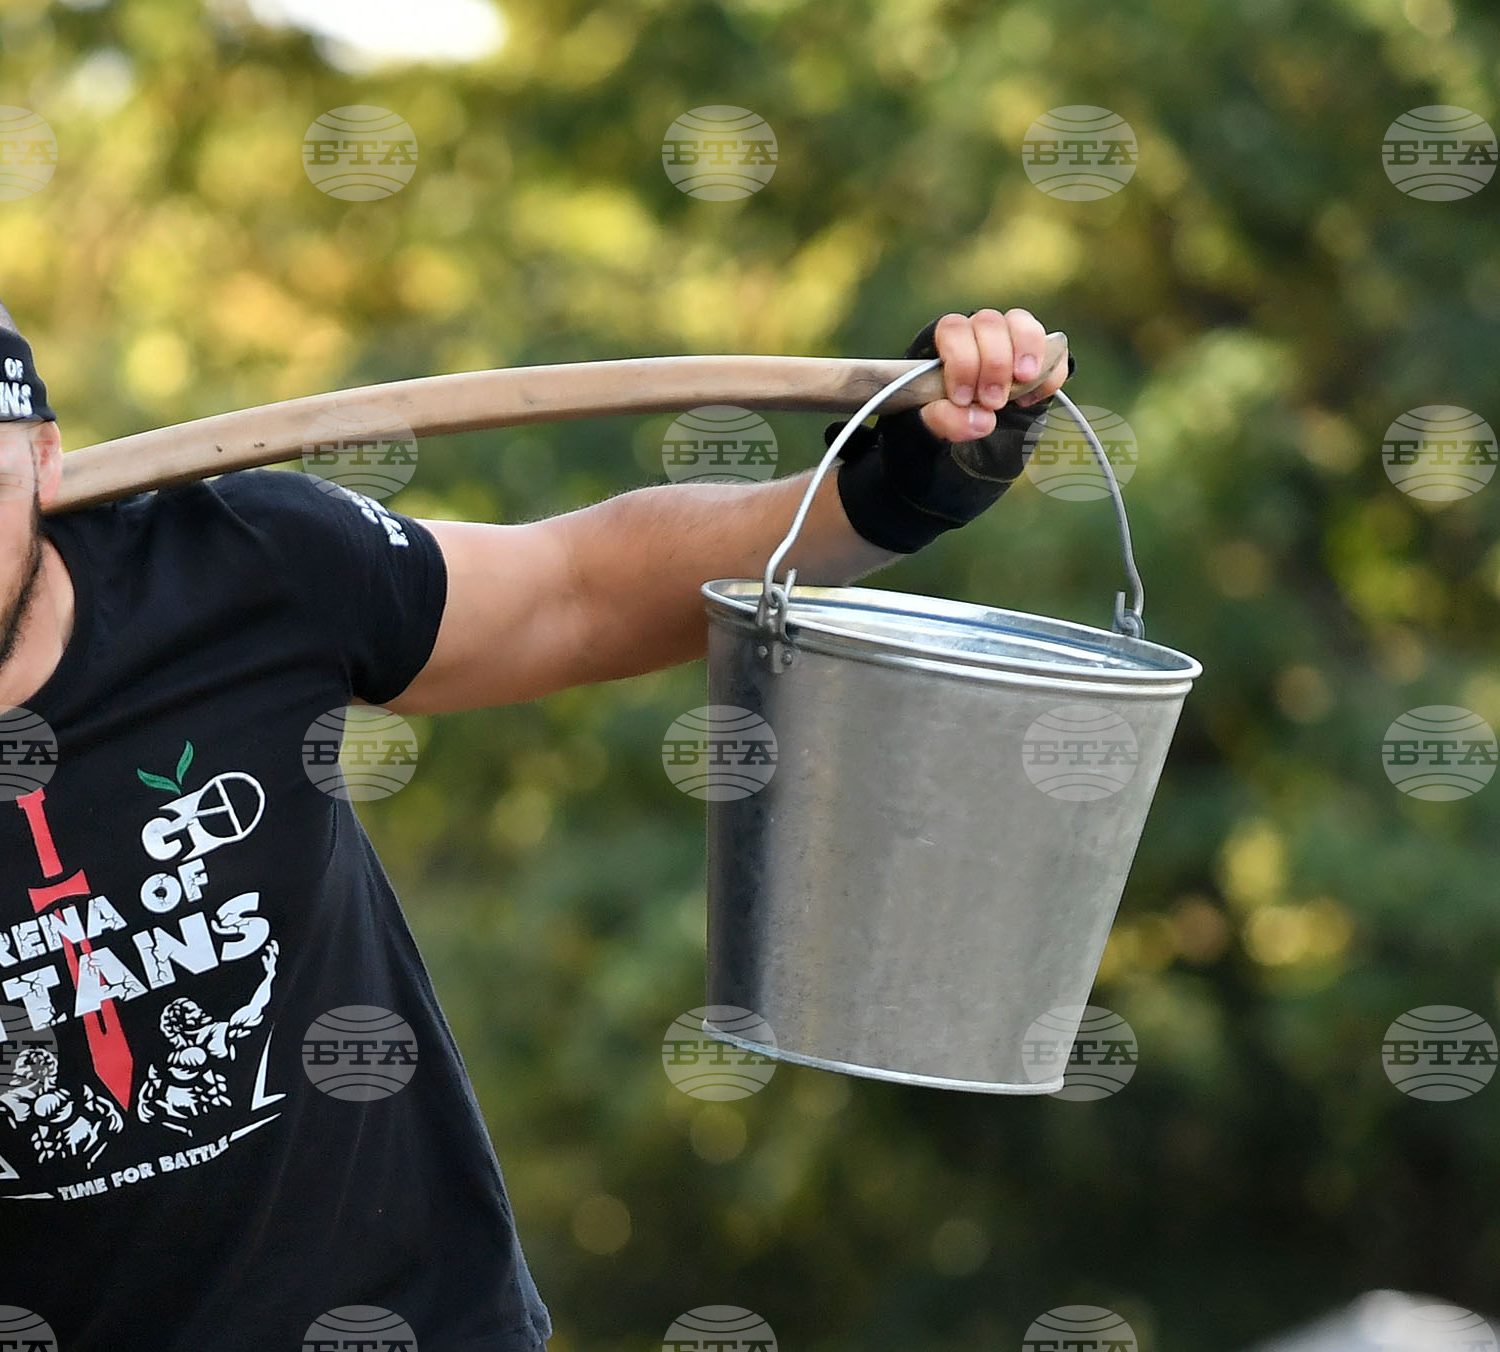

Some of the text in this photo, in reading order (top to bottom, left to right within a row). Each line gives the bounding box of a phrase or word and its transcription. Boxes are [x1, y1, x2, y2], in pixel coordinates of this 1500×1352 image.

[4, 357, 24, 380] OF
[140, 858, 209, 914] OF
[58, 1135, 230, 1201] TIME FOR BATTLE
